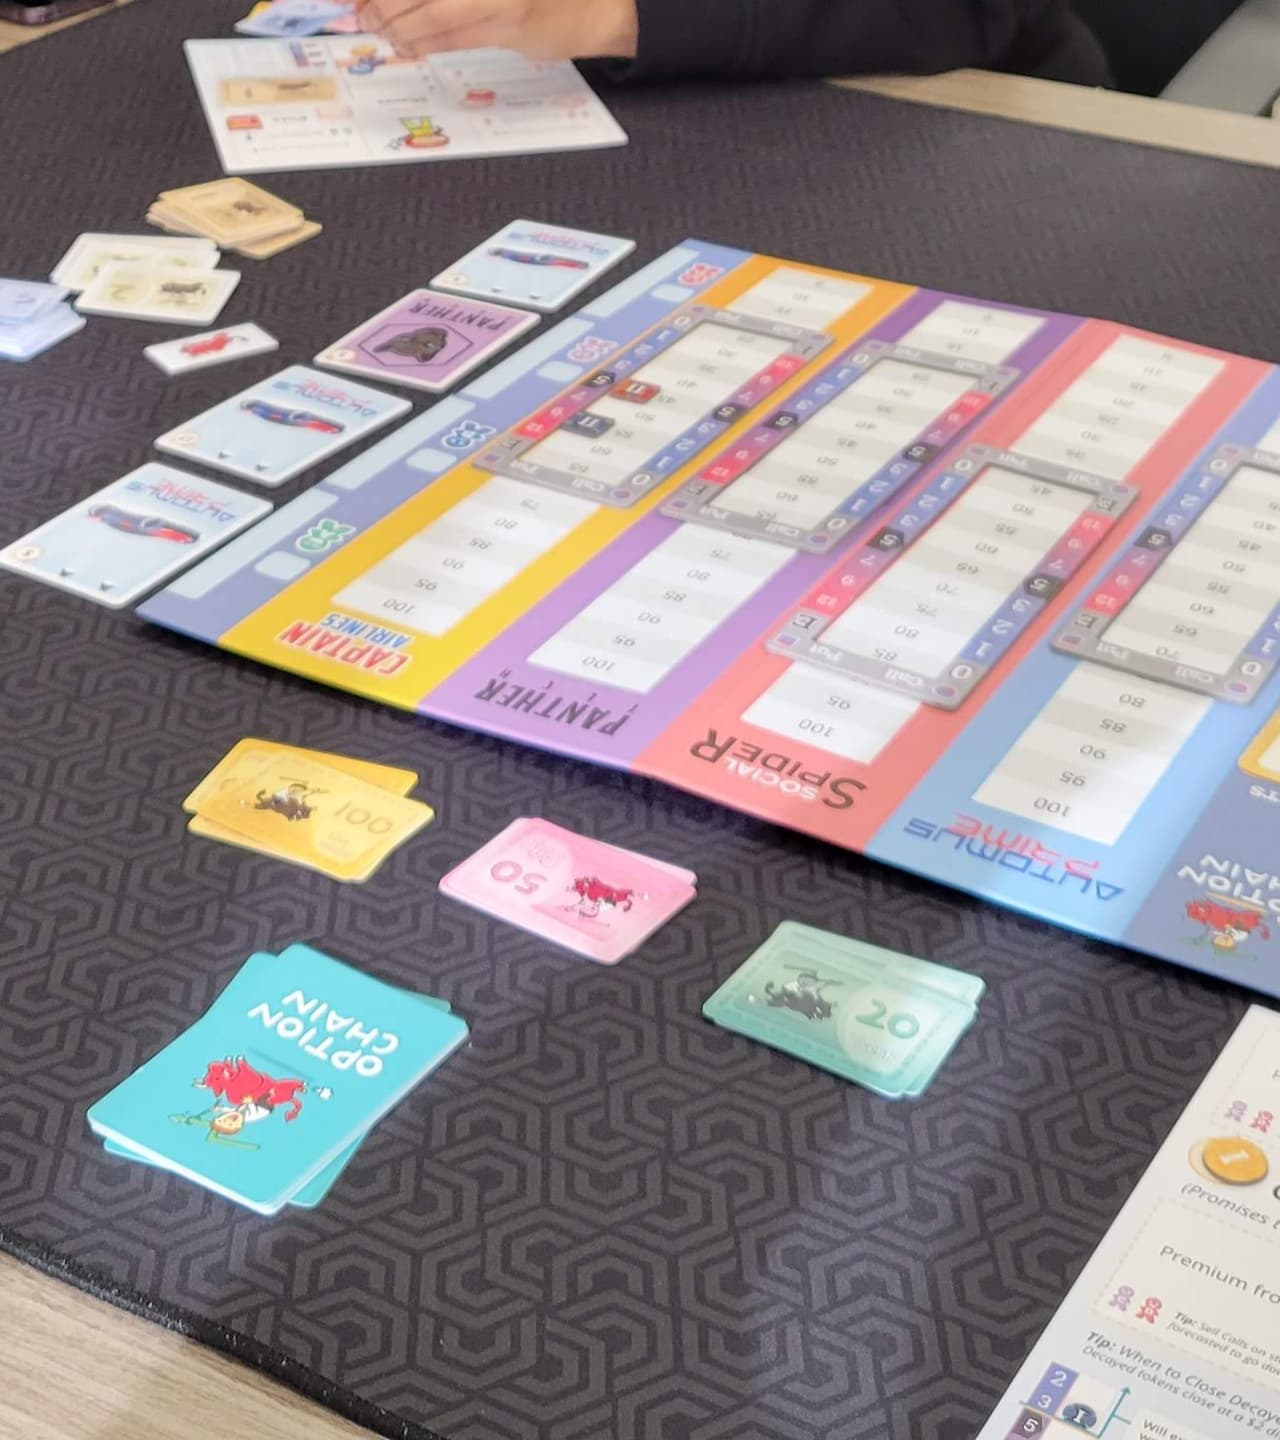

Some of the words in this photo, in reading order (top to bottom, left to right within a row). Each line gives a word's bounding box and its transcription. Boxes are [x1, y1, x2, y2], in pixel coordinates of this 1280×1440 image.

[407, 299, 507, 333] PANTHER
[493, 517, 518, 529] 80
[468, 537, 492, 549] 85
[441, 557, 464, 569] 90
[413, 578, 437, 590] 95
[685, 568, 711, 581] 80
[382, 598, 414, 614] 100
[662, 590, 687, 602] 85
[637, 611, 661, 624] 90
[324, 615, 410, 647] AIRLINES
[612, 634, 635, 647] 95
[278, 623, 409, 673] CAPTAIN
[581, 655, 615, 671] 100
[472, 676, 632, 736] PANTHER
[826, 695, 850, 710] 95
[1118, 693, 1146, 708] 80
[797, 718, 833, 737] 100
[1098, 718, 1126, 733] 85
[1079, 744, 1106, 759] 90
[689, 729, 869, 810] SPIDER
[726, 756, 821, 799] SOCIAL
[1058, 770, 1085, 786] 95
[1032, 796, 1069, 816] 100
[335, 801, 392, 836] 100
[944, 815, 1102, 879] PRIME
[905, 818, 1125, 901] AUTOMUS
[490, 861, 549, 896] 50
[282, 990, 399, 1054] CHAIN
[856, 998, 920, 1039] 20
[248, 1002, 383, 1076] OPTION
[1181, 1183, 1269, 1224] (Promises
[1160, 1245, 1247, 1290] Premium
[1166, 1321, 1231, 1352] forecasted
[1228, 1348, 1242, 1359] to
[1241, 1355, 1259, 1366] go
[1174, 1311, 1197, 1327] Tip:
[1198, 1321, 1221, 1337] Sell
[1220, 1332, 1248, 1349] Calls
[1249, 1345, 1267, 1357] on
[1087, 1331, 1116, 1351] Tip:
[1119, 1344, 1162, 1371] When
[1164, 1366, 1181, 1380] to
[1184, 1375, 1226, 1399] Close
[1049, 1370, 1067, 1388] 2
[1082, 1345, 1137, 1374] Decayed
[1137, 1369, 1180, 1394] tokens
[1181, 1390, 1215, 1410] close
[1216, 1406, 1233, 1417] at
[1232, 1413, 1244, 1423] a
[1246, 1413, 1268, 1432] $2
[1037, 1394, 1052, 1409] 3
[1023, 1417, 1038, 1432] 5
